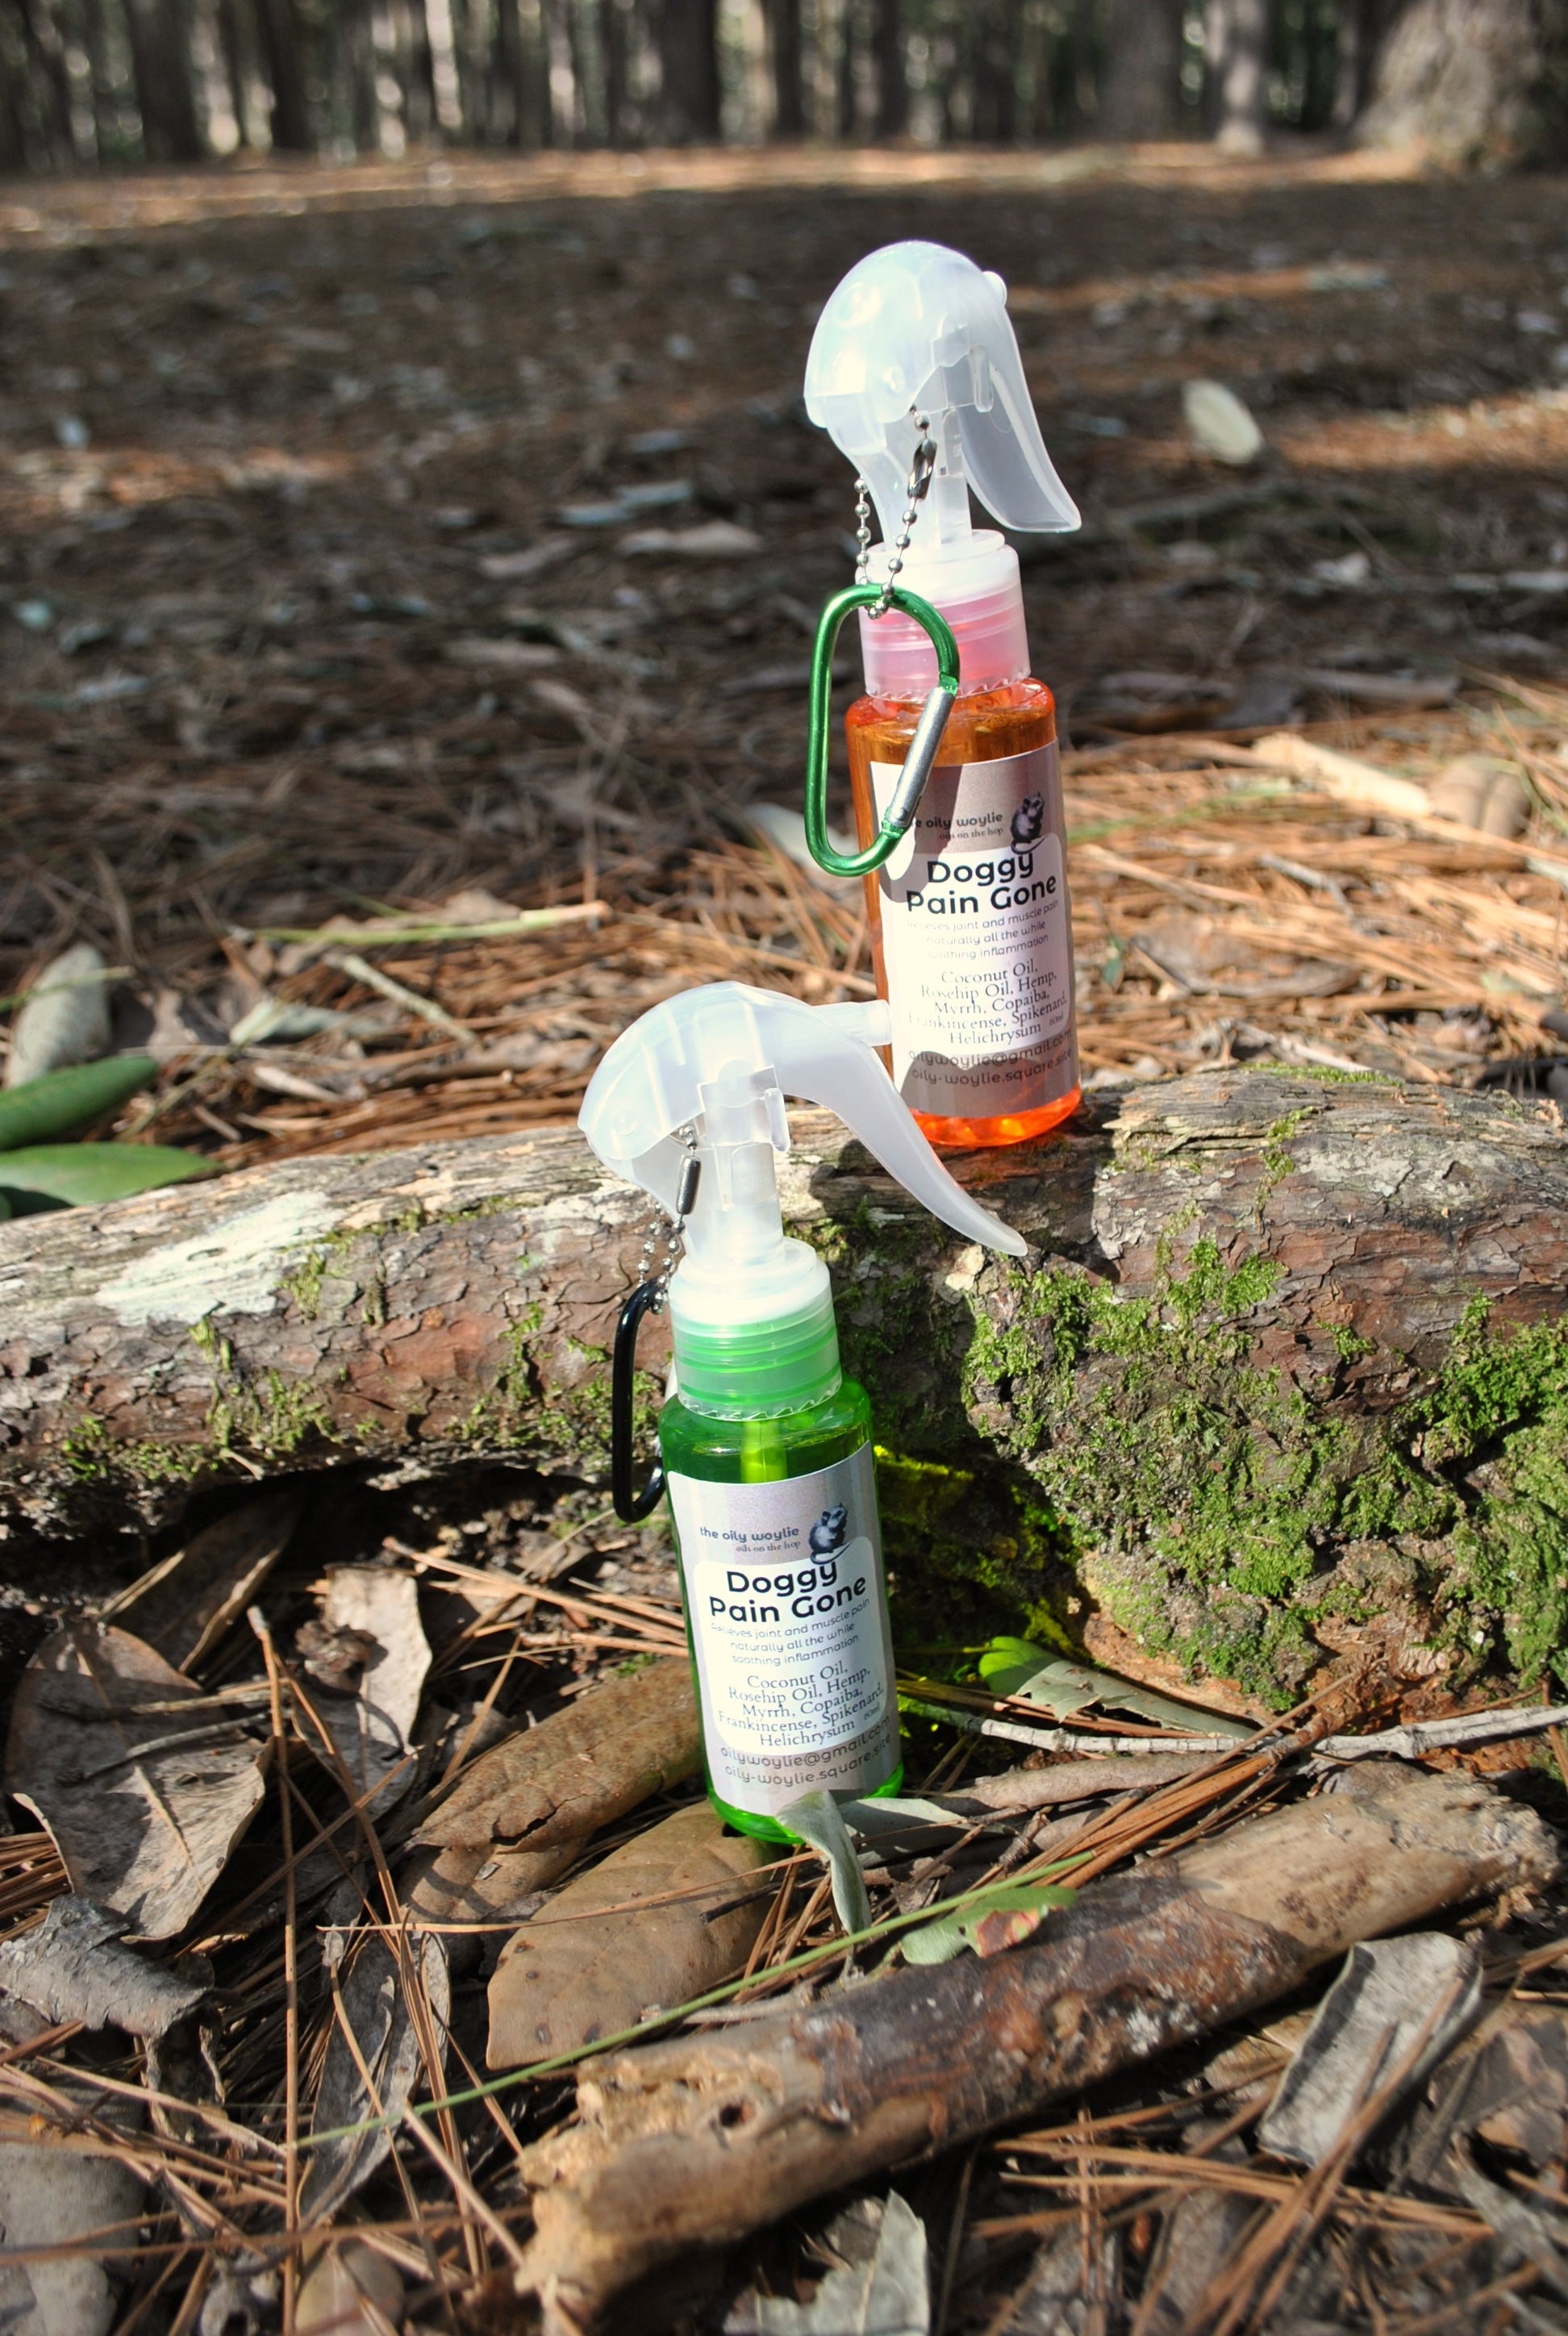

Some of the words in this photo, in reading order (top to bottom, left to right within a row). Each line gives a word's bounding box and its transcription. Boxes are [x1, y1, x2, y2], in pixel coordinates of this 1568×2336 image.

[926, 816, 951, 830] oily
[957, 811, 1003, 828] woylie
[928, 853, 1033, 886] Doggy
[907, 890, 978, 915] Pain
[990, 875, 1057, 910] Gone
[953, 921, 978, 932] joint
[982, 916, 1005, 928] and
[1008, 907, 1041, 924] muscle
[1043, 899, 1059, 916] pain
[980, 934, 1049, 957] inflammation
[984, 932, 999, 943] all
[1001, 928, 1019, 940] the
[1021, 920, 1045, 936] while
[941, 970, 1007, 984] Coconut
[1012, 959, 1038, 975] Oil,
[985, 981, 1013, 998] Oil,
[1018, 970, 1057, 993] Hemp,
[935, 1000, 986, 1015] Myrrh,
[992, 987, 1049, 1015] Copaiba,
[909, 1028, 1072, 1068] oilywoylie@gmail.com
[950, 1023, 1041, 1045] Helichrysum
[912, 1048, 1072, 1087] oily-woylie.square.site
[699, 1526, 719, 1540] the
[723, 1528, 746, 1543] oily
[751, 1525, 799, 1542] woylie
[767, 1541, 782, 1552] the
[784, 1541, 801, 1551] hop
[727, 1562, 836, 1597] Doggy
[710, 1596, 779, 1623] Pain
[791, 1576, 866, 1618] Gone
[755, 1629, 782, 1639] joint
[785, 1625, 807, 1637] and
[811, 1611, 849, 1631] muscle
[852, 1598, 870, 1617] pain
[730, 1640, 783, 1653] naturally
[786, 1639, 803, 1650] all
[805, 1634, 824, 1647] the
[828, 1622, 854, 1641] while
[731, 1654, 781, 1666] soothing
[784, 1634, 858, 1663] inflammation
[728, 1686, 786, 1705] Rosehip
[792, 1685, 823, 1702] Oil,
[827, 1666, 870, 1693] Hemp,
[747, 1675, 815, 1689] Coconut
[819, 1662, 848, 1679] Oil,
[742, 1704, 795, 1719] Myrrh,
[800, 1687, 863, 1716] Copaiba,
[719, 1710, 818, 1732] Frankincense,
[761, 1720, 855, 1747] Helichrysum
[721, 1715, 890, 1770] oilywoylie@gmail.com
[725, 1732, 891, 1787] oily-woylie.square.site
